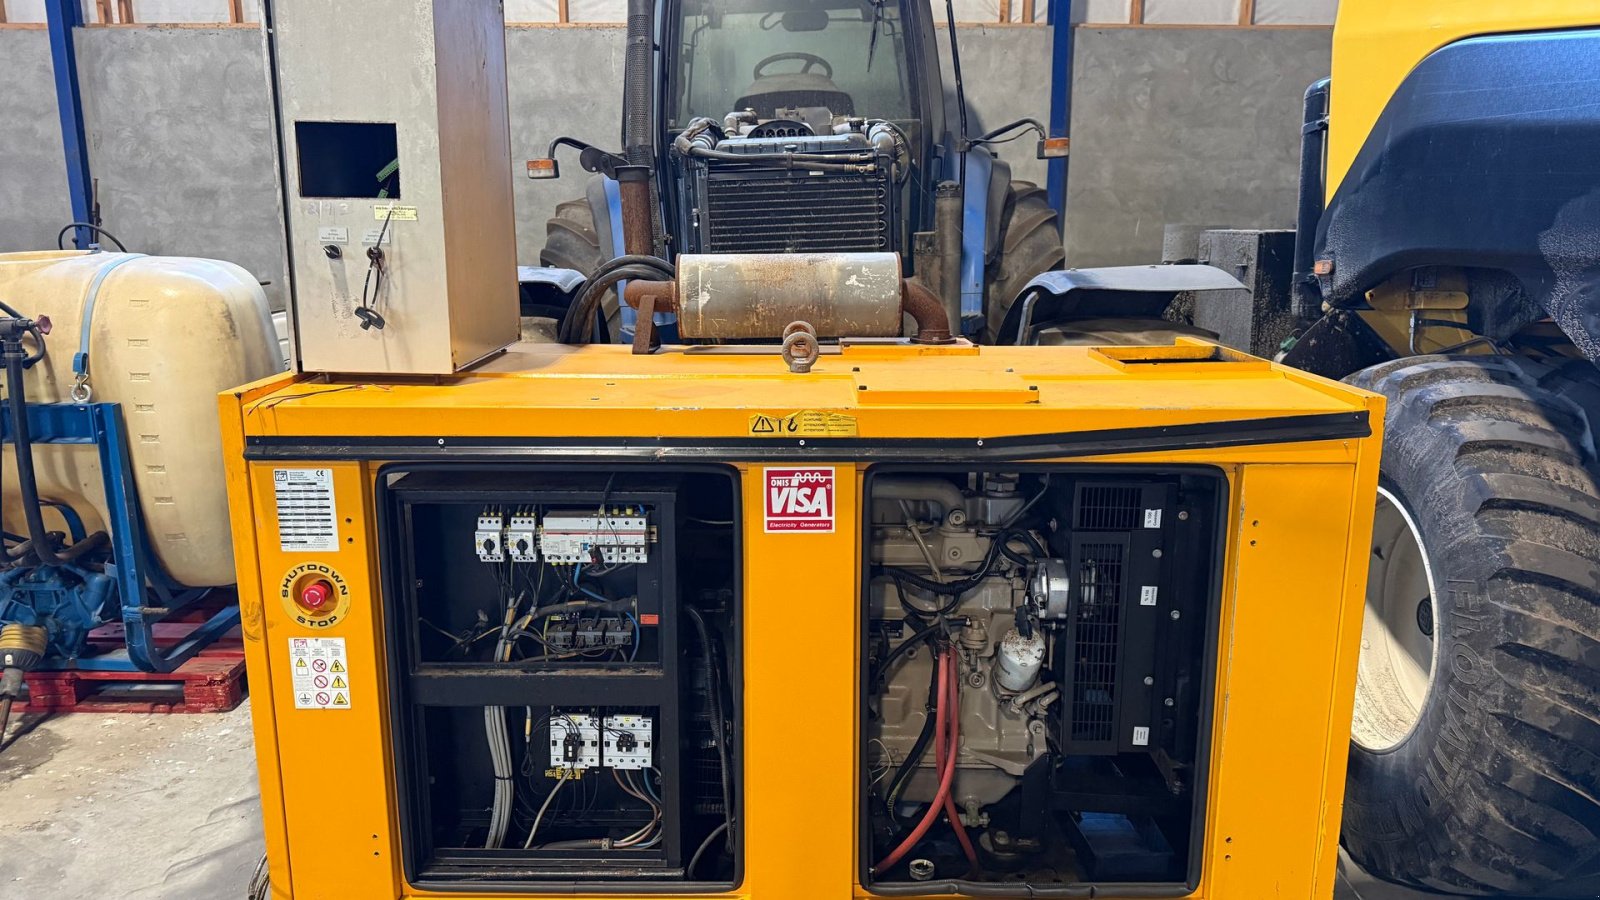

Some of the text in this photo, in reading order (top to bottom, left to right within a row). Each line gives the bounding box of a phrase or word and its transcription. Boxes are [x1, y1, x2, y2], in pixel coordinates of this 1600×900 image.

[770, 485, 828, 518] VISA
[282, 564, 348, 598] SHUTDOWN
[296, 615, 338, 628] STOP
